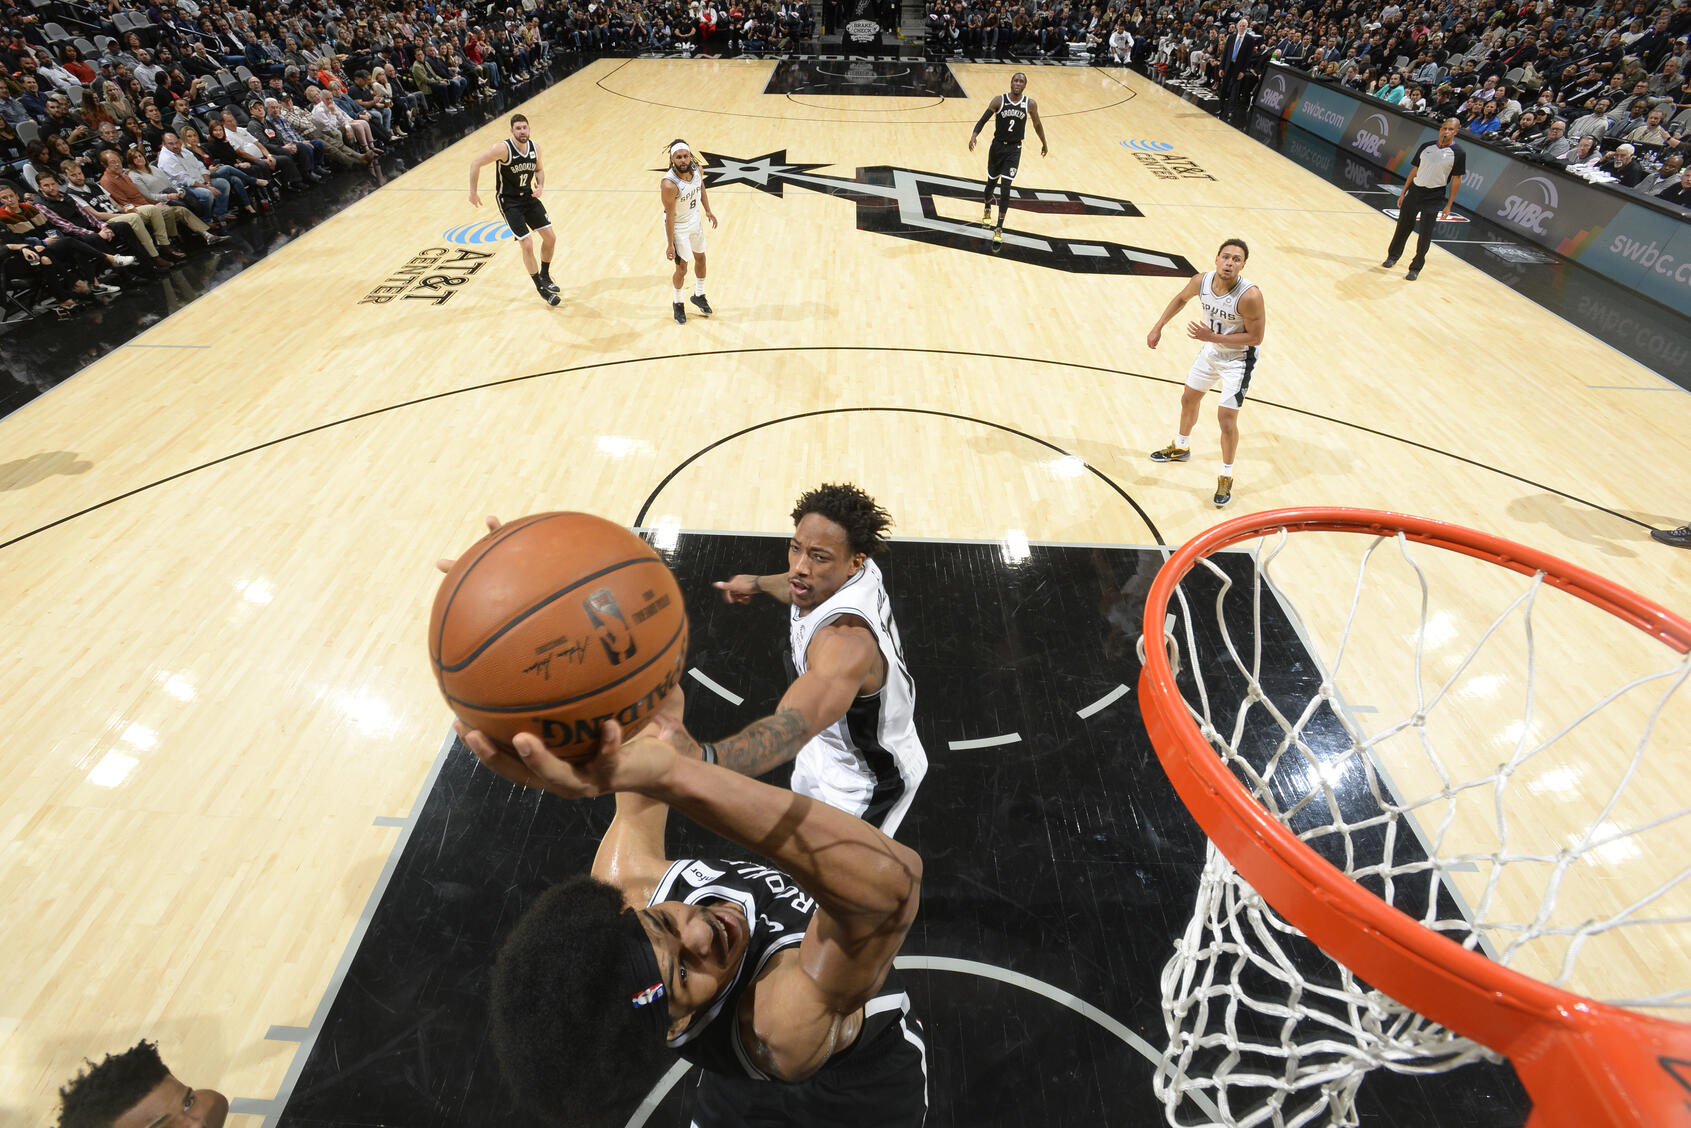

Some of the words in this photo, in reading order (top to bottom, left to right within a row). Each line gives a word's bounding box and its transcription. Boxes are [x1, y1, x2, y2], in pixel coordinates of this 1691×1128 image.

[1260, 87, 1284, 111] SWBC
[1008, 119, 1015, 132] 2
[1302, 101, 1345, 129] swbc.com
[1351, 129, 1386, 158] SWBC
[519, 173, 529, 187] 12
[1153, 152, 1219, 182] AT&T
[690, 199, 697, 209] 8
[1497, 195, 1555, 234] SWBC
[1609, 234, 1691, 286] swbc.c
[357, 247, 450, 304] CENTER
[400, 248, 496, 306] AT&T
[1210, 319, 1223, 335] 11
